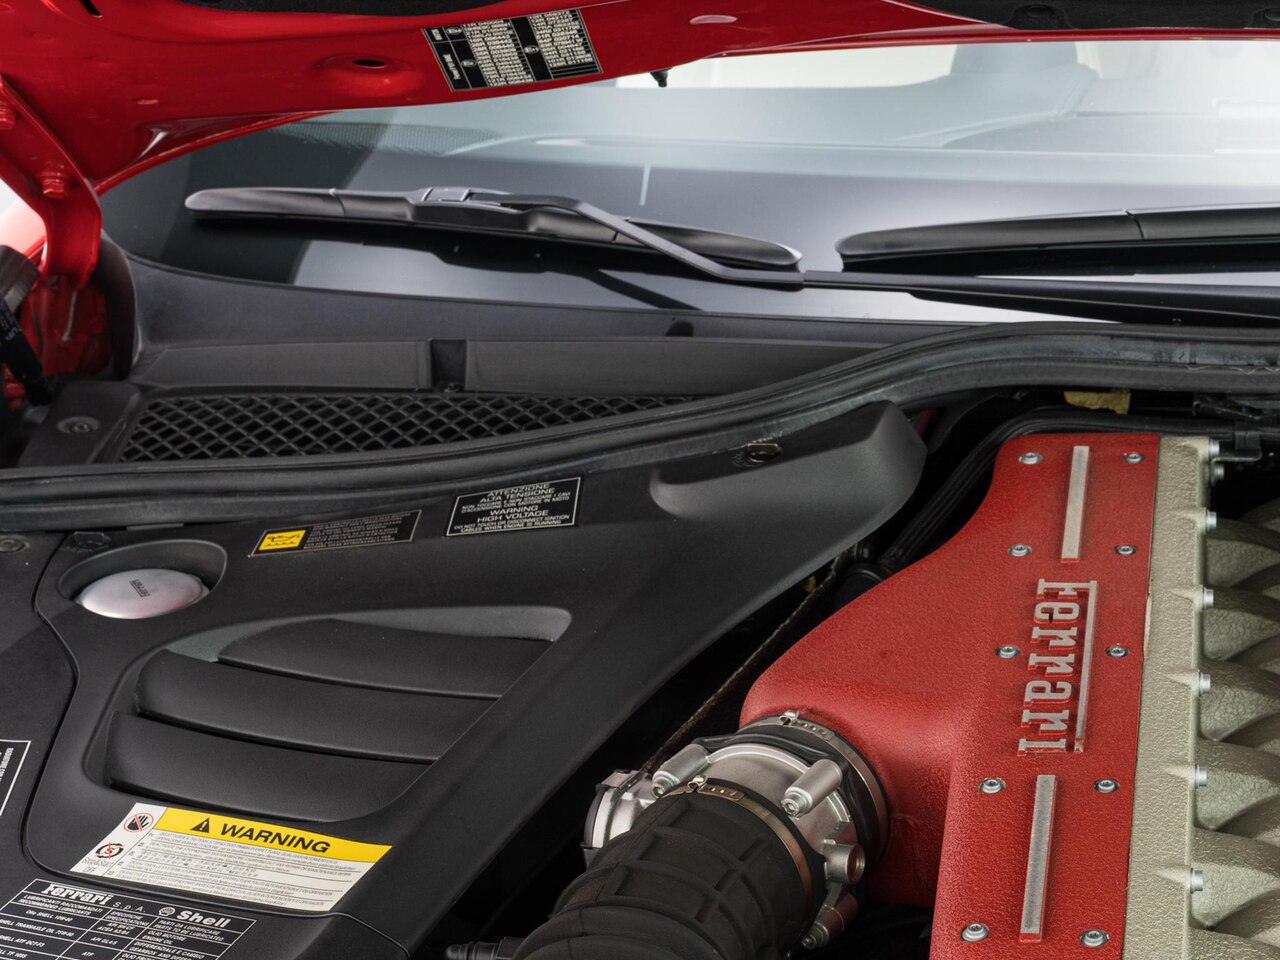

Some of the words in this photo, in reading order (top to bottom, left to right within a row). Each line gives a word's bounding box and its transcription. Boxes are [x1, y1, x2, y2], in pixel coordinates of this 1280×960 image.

[479, 495, 502, 503] ALTA
[505, 487, 554, 499] TENSIONE
[487, 482, 549, 497] ATTENZIONE
[476, 514, 502, 522] HIGH
[504, 509, 549, 519] VOLTAGE
[489, 504, 539, 515] WARNING
[1017, 578, 1097, 757] Ferrari
[214, 823, 335, 853] WARNING
[40, 883, 113, 904] Ferrari
[175, 910, 232, 927] Shell
